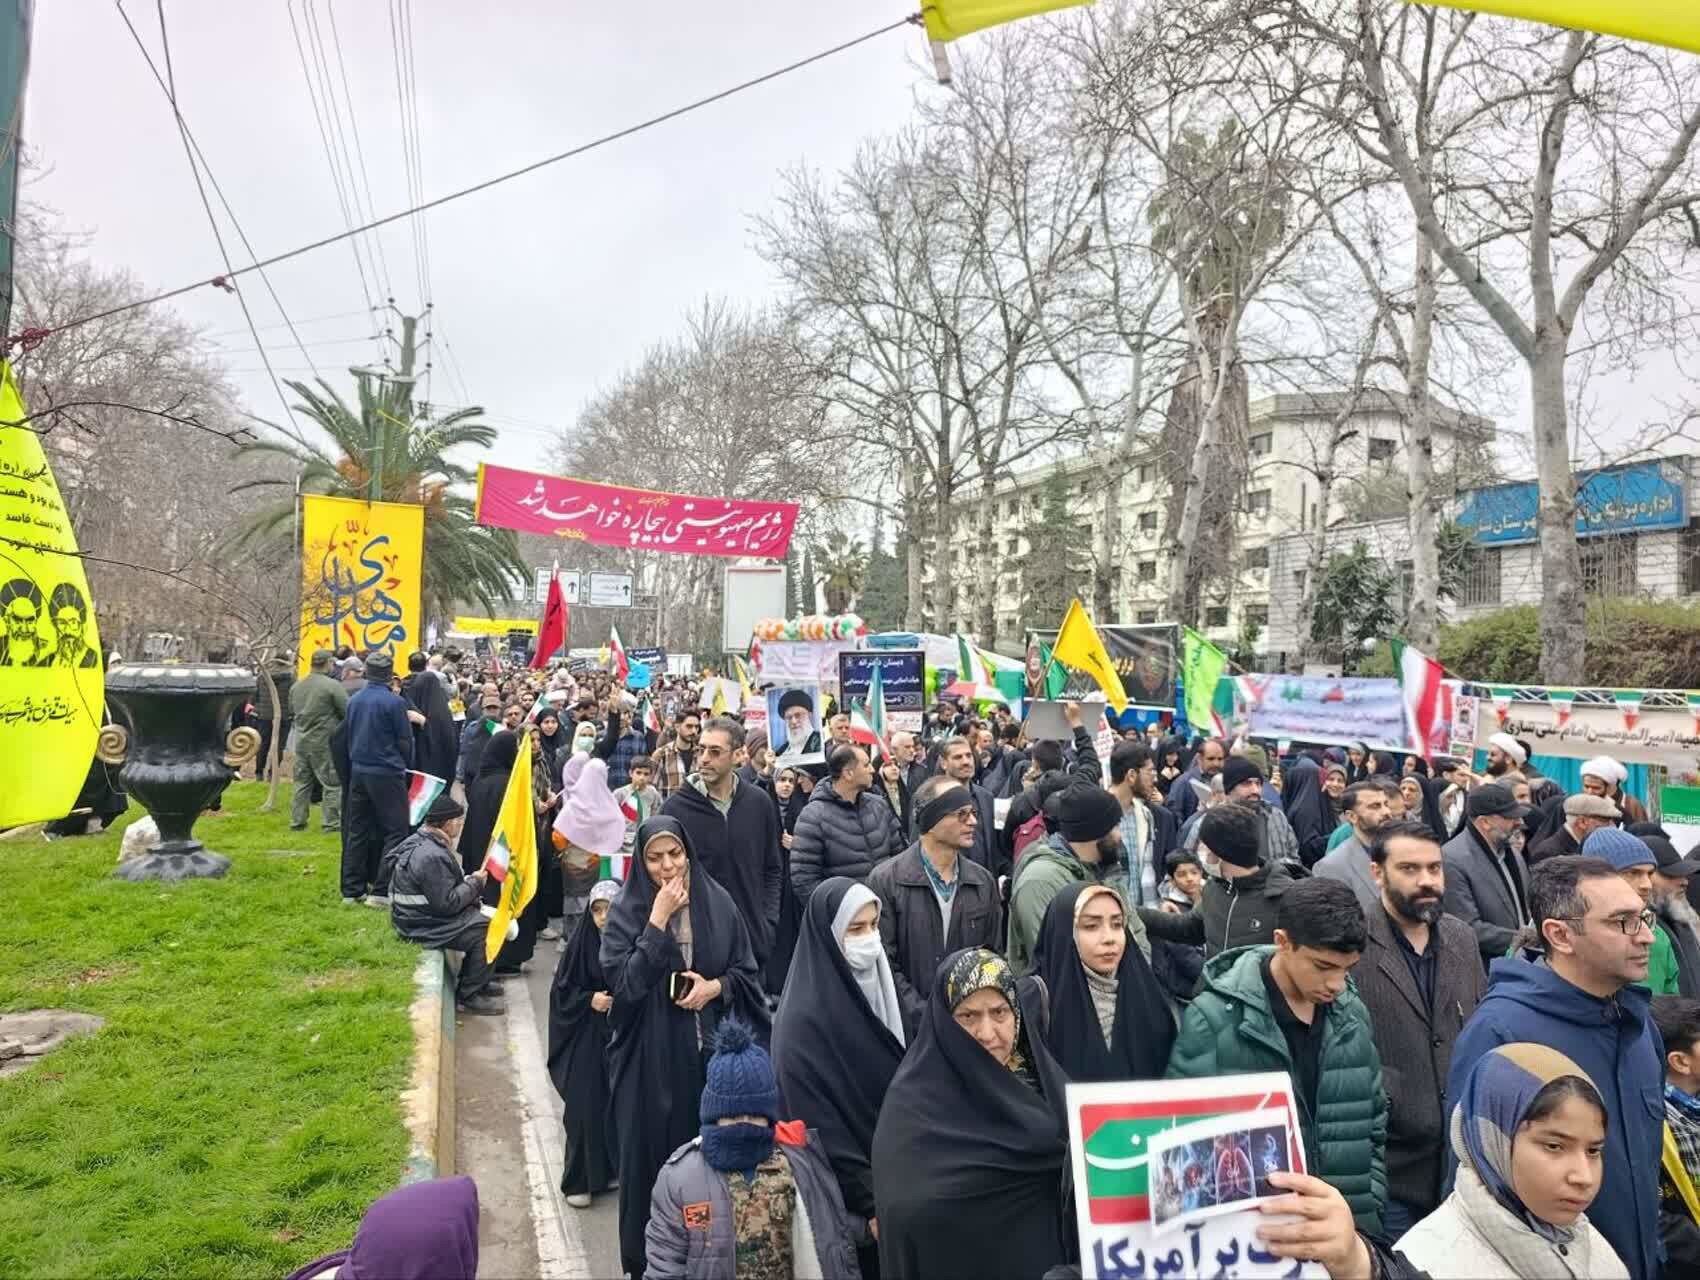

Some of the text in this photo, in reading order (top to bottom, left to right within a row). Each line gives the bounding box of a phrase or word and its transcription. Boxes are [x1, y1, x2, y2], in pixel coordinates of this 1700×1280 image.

[517, 479, 545, 505] شد
[533, 496, 622, 527] خواهد
[661, 501, 753, 547] صهیونیستی
[744, 511, 783, 550] رژیم
